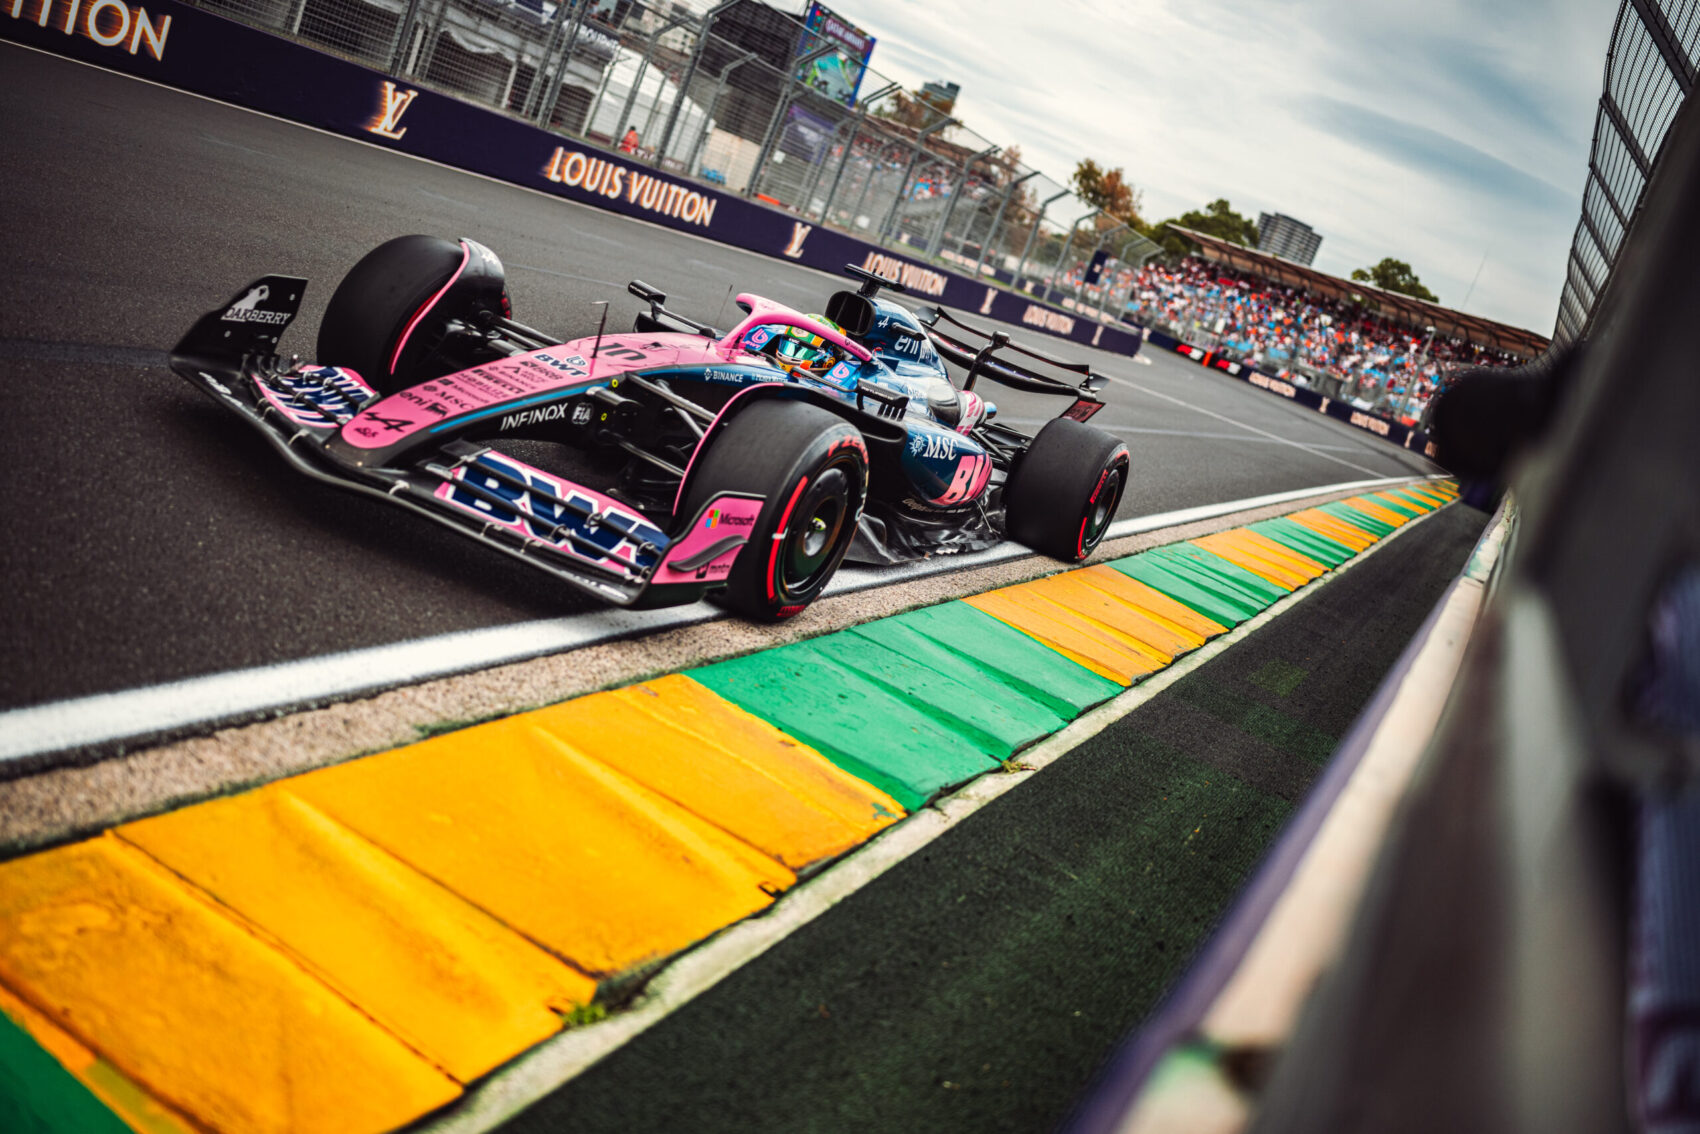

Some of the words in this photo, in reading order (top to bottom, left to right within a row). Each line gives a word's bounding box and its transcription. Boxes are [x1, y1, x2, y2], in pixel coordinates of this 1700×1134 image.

[549, 146, 626, 199] LOUIS
[627, 171, 717, 227] VUITTON
[224, 307, 292, 325] OAKBERRY
[532, 353, 588, 376] BWT
[712, 371, 744, 383] BINANCE
[400, 391, 431, 406] eni
[501, 403, 568, 431] INFINOX
[923, 434, 959, 461] MSC
[719, 512, 756, 527] Microsoft
